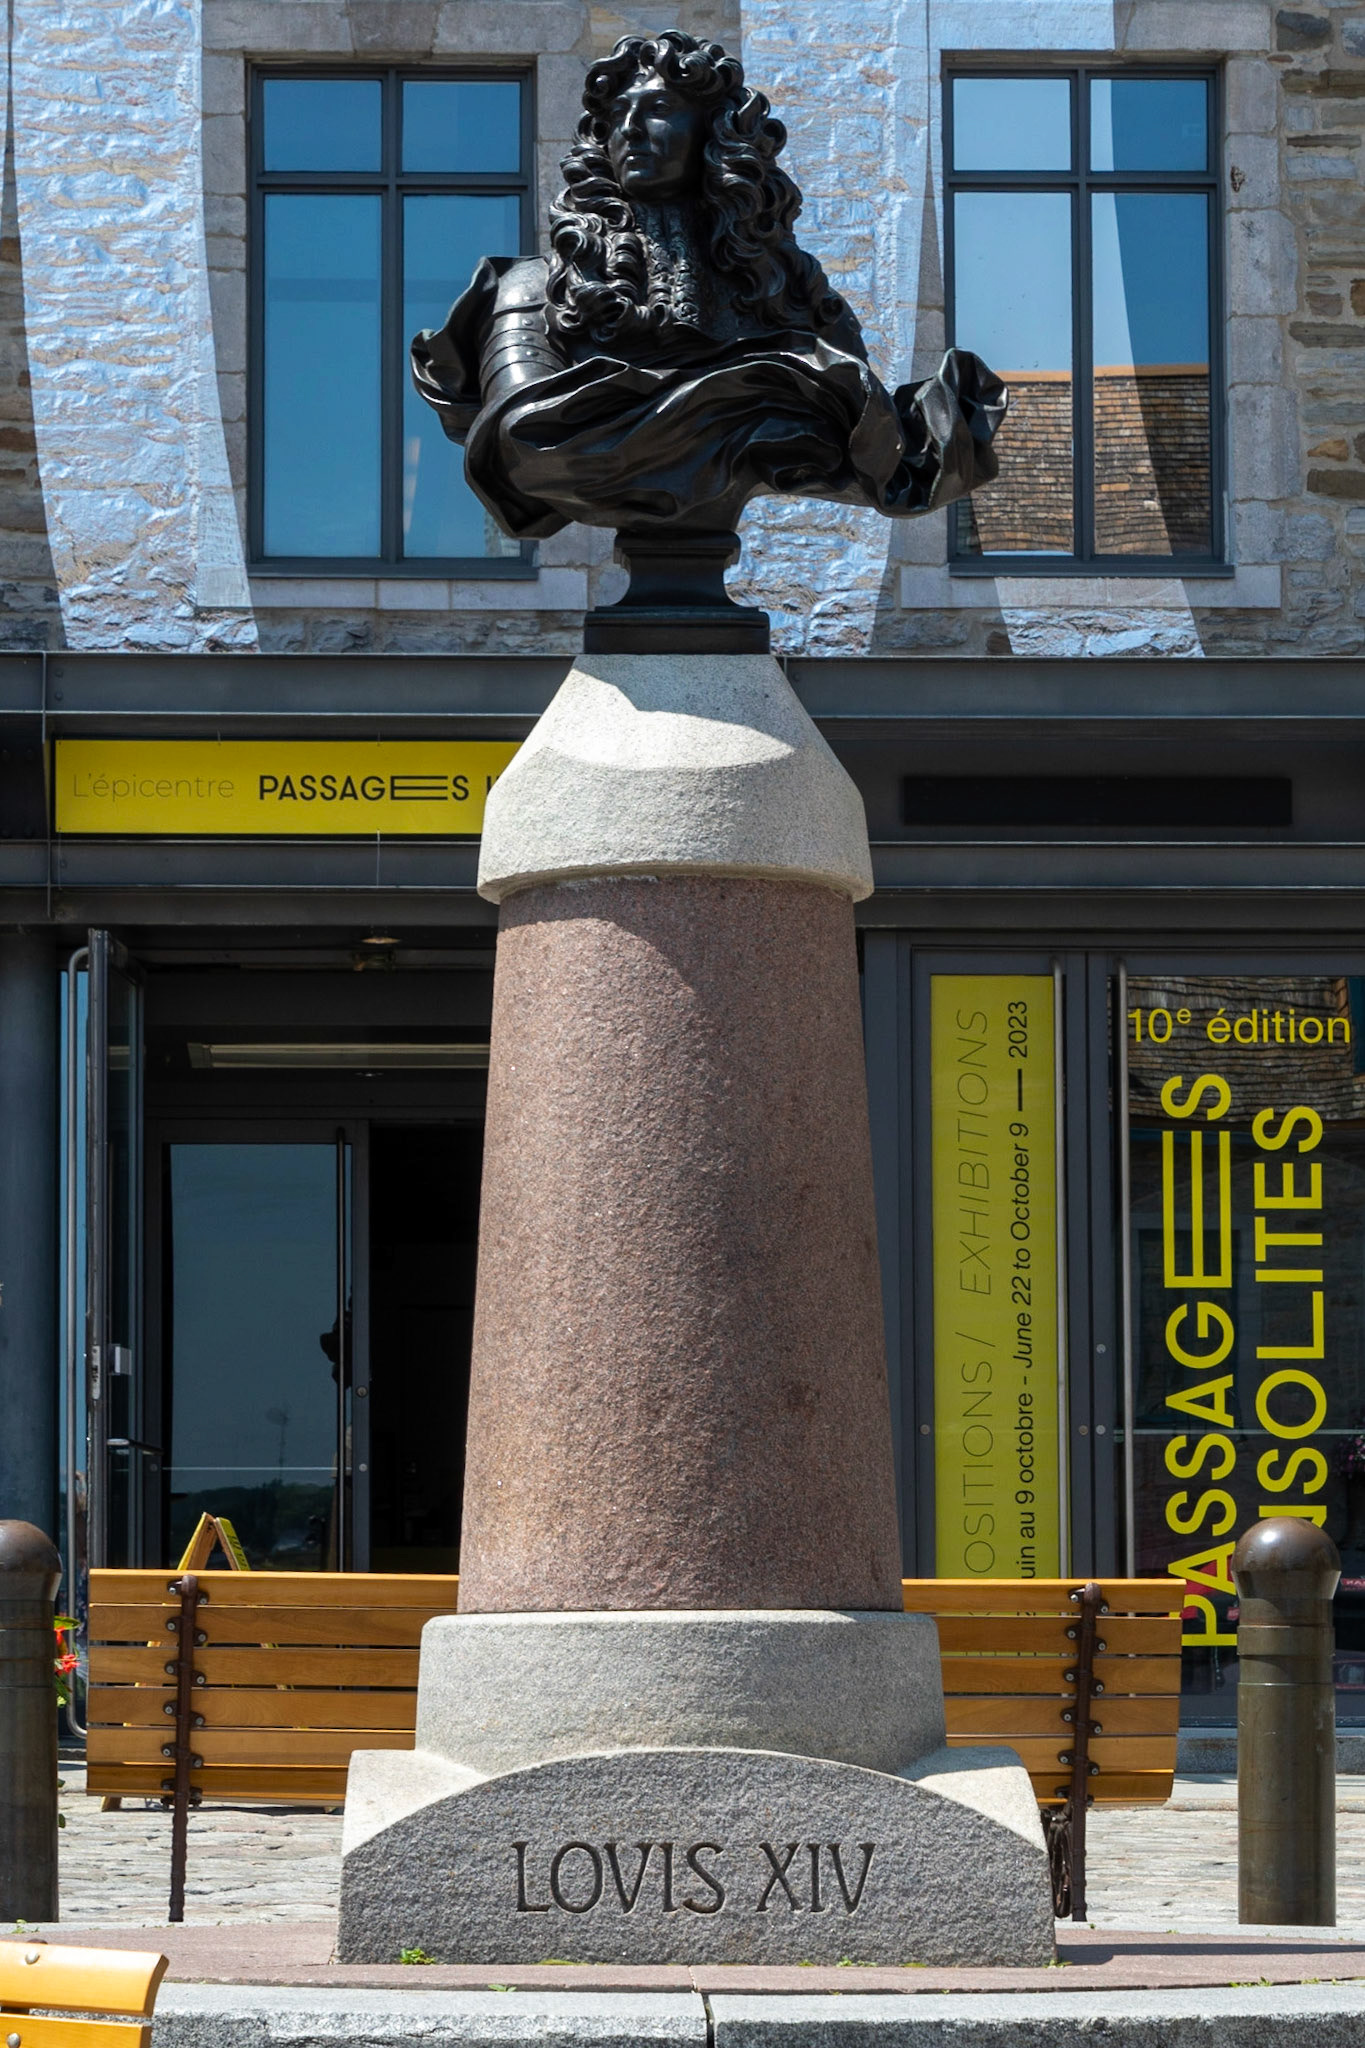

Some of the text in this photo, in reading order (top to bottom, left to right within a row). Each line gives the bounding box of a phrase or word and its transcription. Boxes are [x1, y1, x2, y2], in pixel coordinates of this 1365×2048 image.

[73, 773, 235, 802] L'épicentre
[259, 774, 470, 801] PASSAGES
[1007, 1001, 1028, 1059] 2023
[1206, 1007, 1351, 1045] édition
[956, 1008, 992, 1296] EXHIBITIONS
[1008, 1122, 1029, 1137] 9
[1009, 1142, 1031, 1241] October
[1012, 1247, 1031, 1270] to
[1011, 1275, 1032, 1307] 22
[1012, 1312, 1033, 1369] June
[1160, 1073, 1239, 1647] PASSAGES
[1013, 1392, 1035, 1484] octobre
[961, 1360, 996, 1574] OSITIONS
[1014, 1489, 1035, 1505] 9
[1019, 1511, 1036, 1539] au
[1015, 1546, 1036, 1579] uin
[510, 1841, 877, 1915] LOVIS XIV
